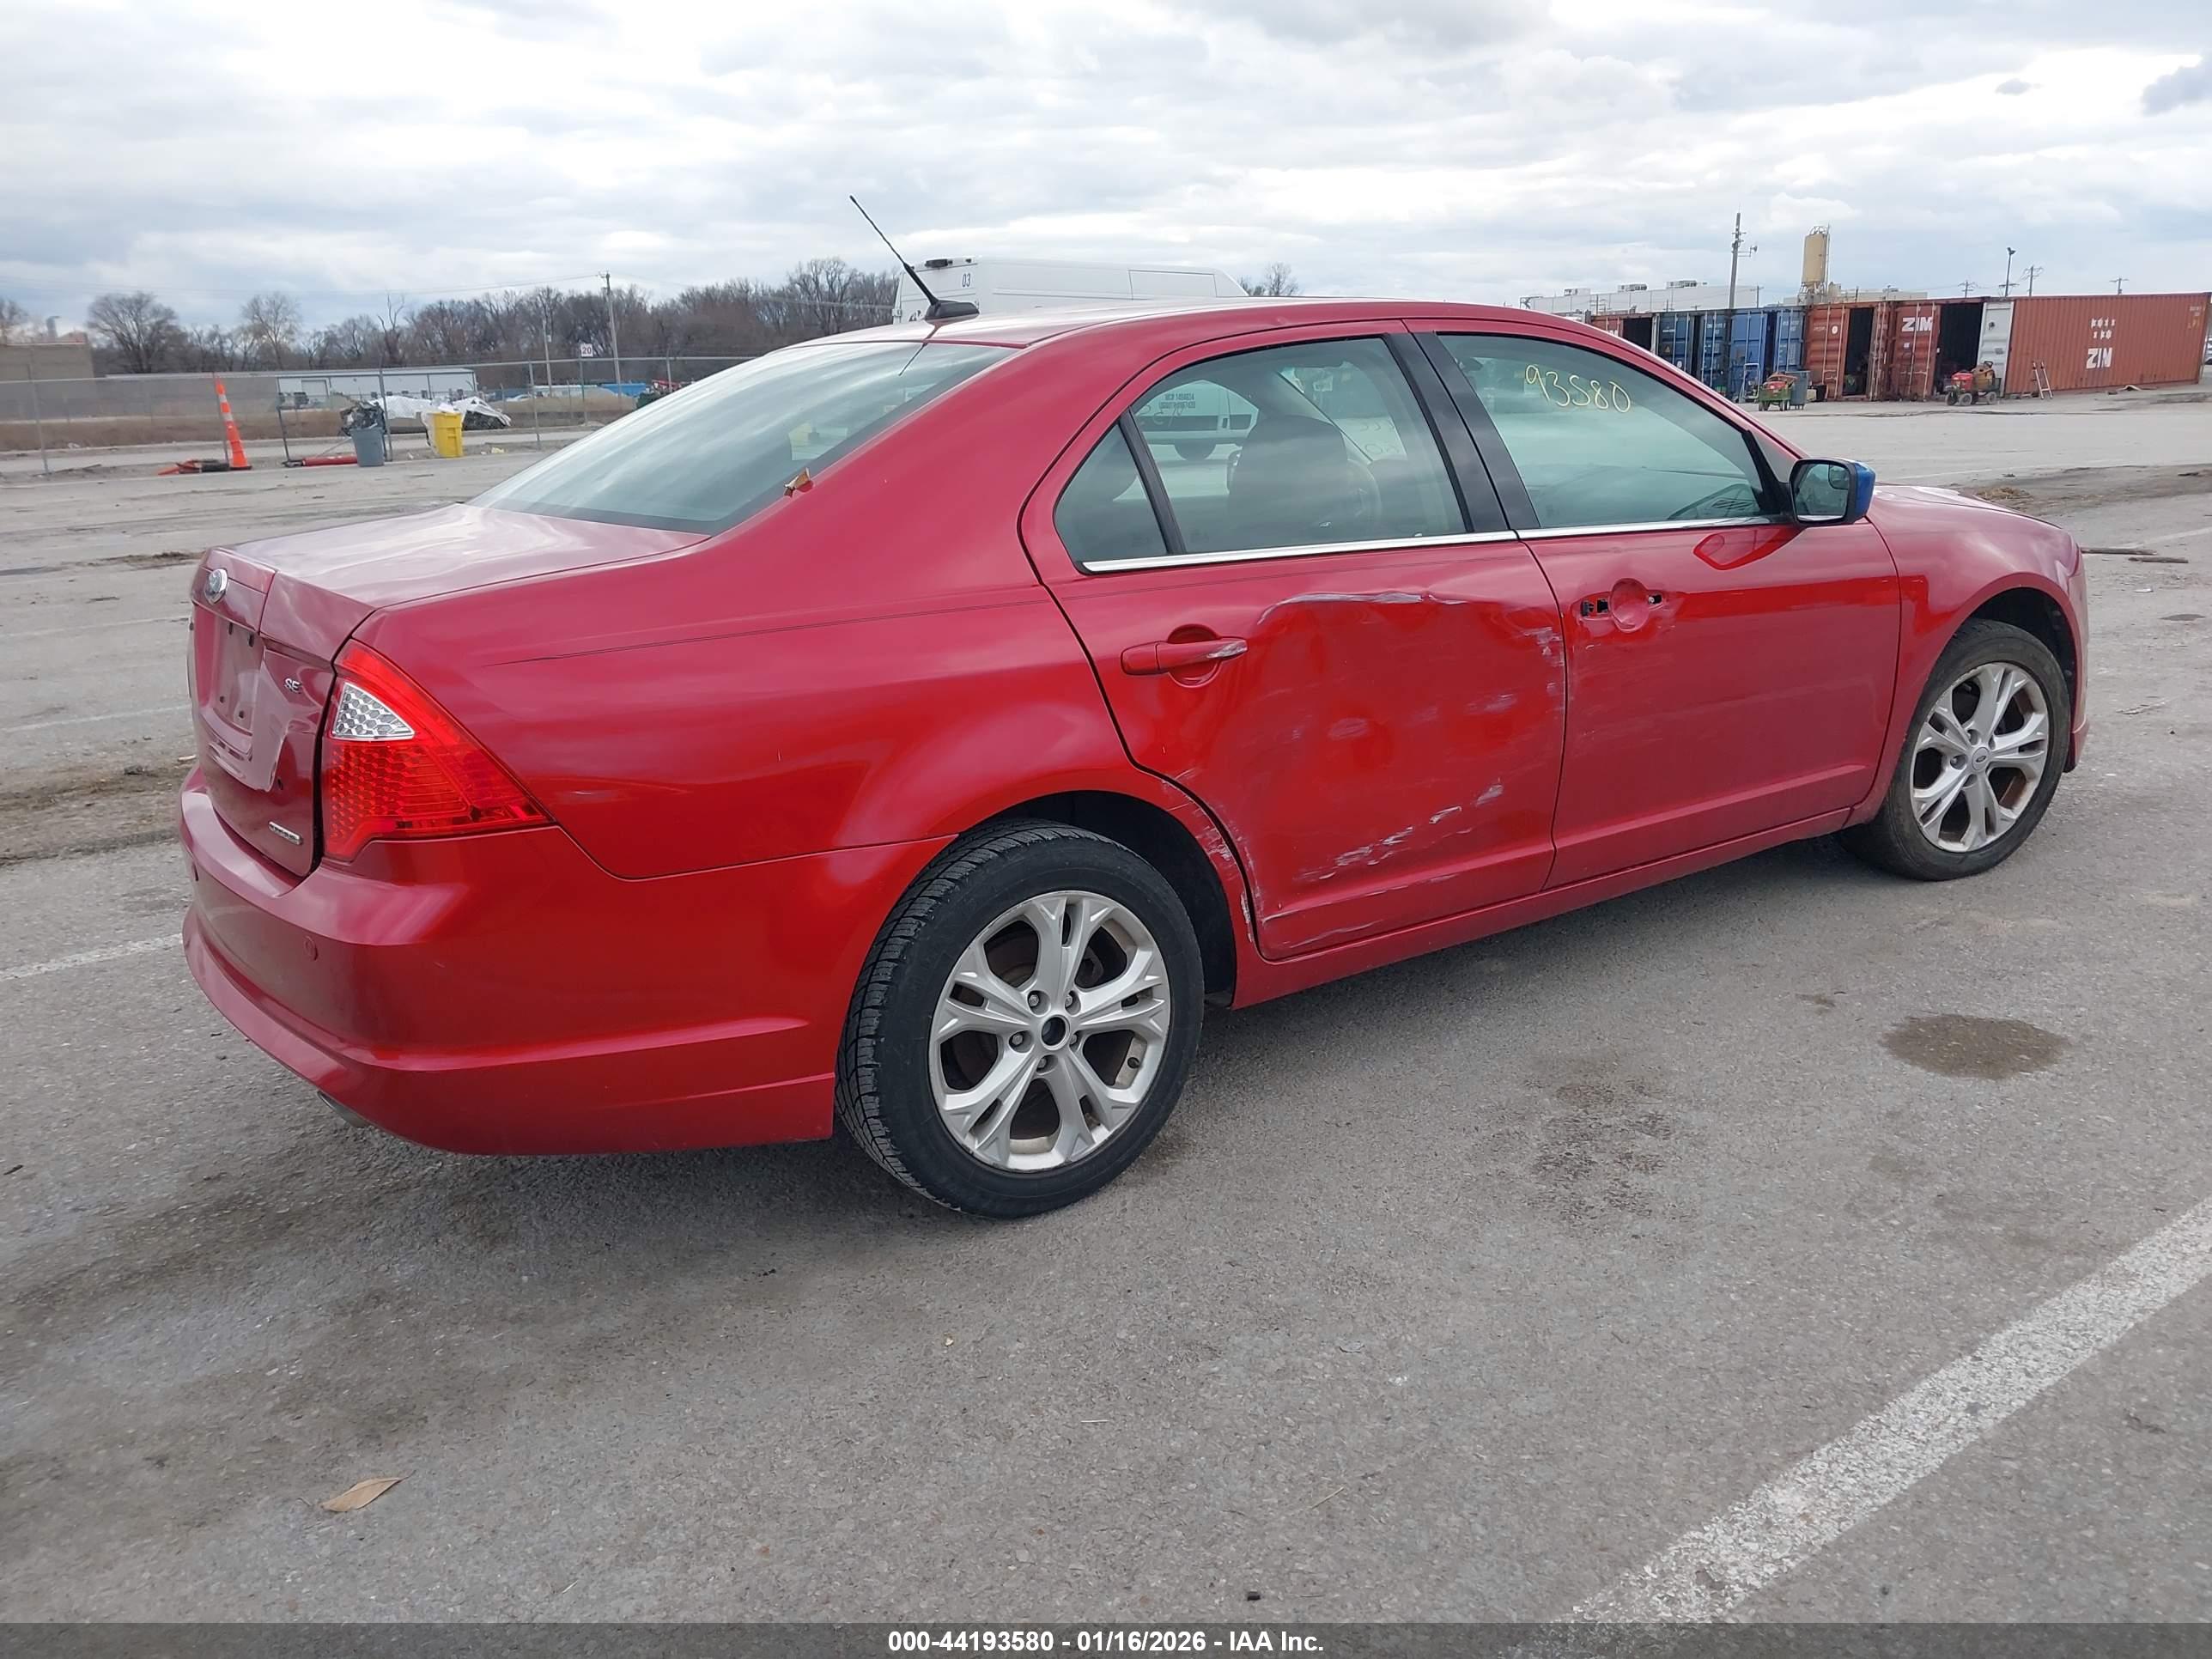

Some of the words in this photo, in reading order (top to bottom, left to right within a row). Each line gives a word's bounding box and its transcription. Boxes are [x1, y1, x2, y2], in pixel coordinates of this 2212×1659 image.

[962, 273, 971, 287] 03
[1901, 317, 1933, 331] ZIM
[1525, 364, 1631, 412] 93580
[284, 678, 301, 693] SE
